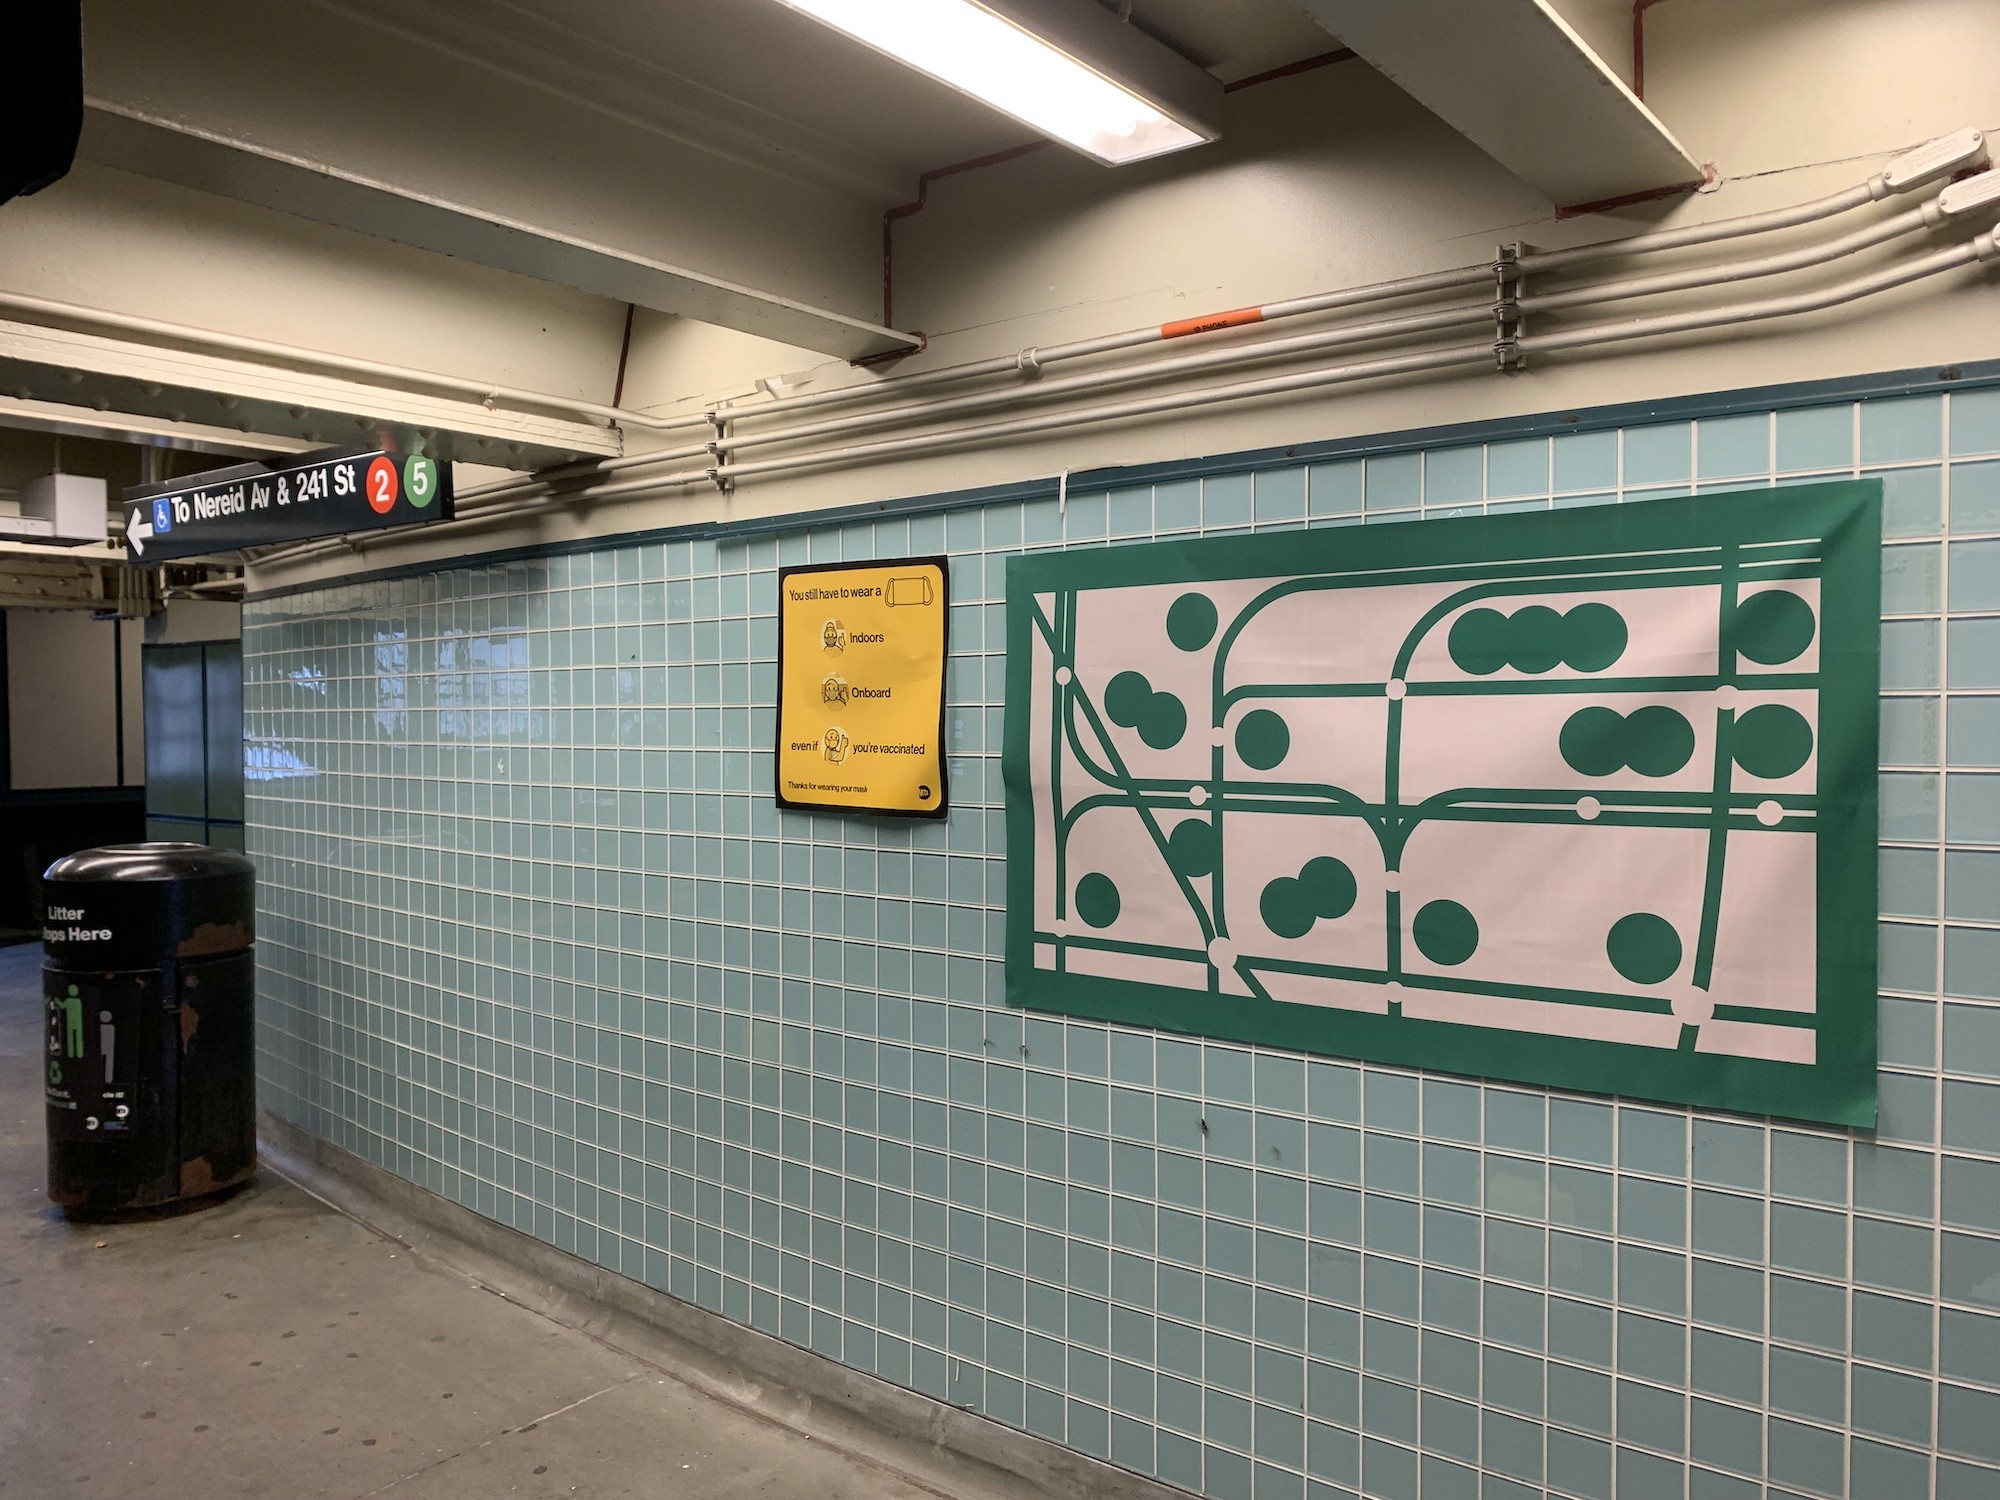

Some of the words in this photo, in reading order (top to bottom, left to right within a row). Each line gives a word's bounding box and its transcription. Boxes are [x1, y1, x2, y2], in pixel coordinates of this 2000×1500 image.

[171, 496, 190, 523] To
[193, 484, 245, 520] Nereid
[250, 481, 270, 510] Av
[276, 476, 291, 506] &
[296, 468, 328, 502] 241
[333, 464, 356, 496] St
[374, 469, 390, 502] 2
[412, 461, 428, 495] 5
[789, 589, 804, 601] You
[819, 587, 839, 600] have
[840, 587, 850, 599] to
[850, 587, 874, 598] wear
[875, 587, 882, 597] a
[849, 632, 885, 644] Indoors
[851, 687, 891, 699] Onboard
[791, 742, 812, 751] even
[812, 741, 819, 751] if
[852, 742, 879, 755] you're
[879, 743, 926, 755] vaccinated
[787, 781, 807, 790] Thanks
[47, 905, 86, 921] Litter
[67, 926, 113, 942] Here
